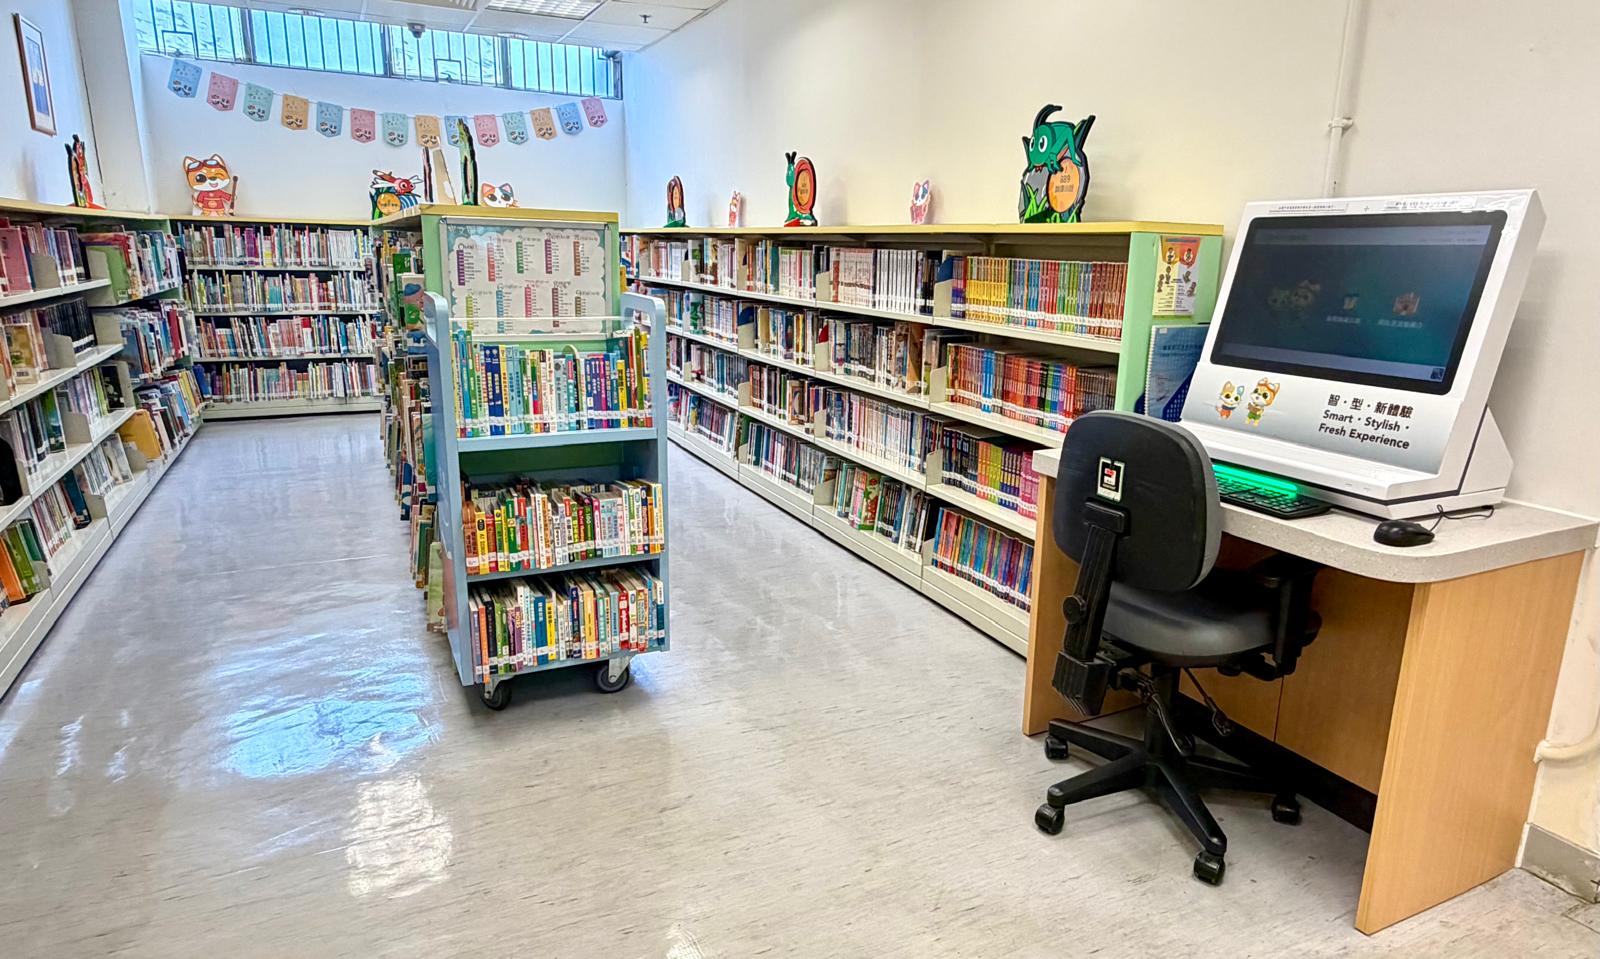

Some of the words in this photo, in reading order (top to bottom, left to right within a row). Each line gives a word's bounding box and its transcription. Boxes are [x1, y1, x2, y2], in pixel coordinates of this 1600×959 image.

[1323, 410, 1353, 423] Smart
[1364, 417, 1400, 431] Stylish
[1318, 423, 1346, 436] Fresh
[1349, 428, 1410, 449] Experience
